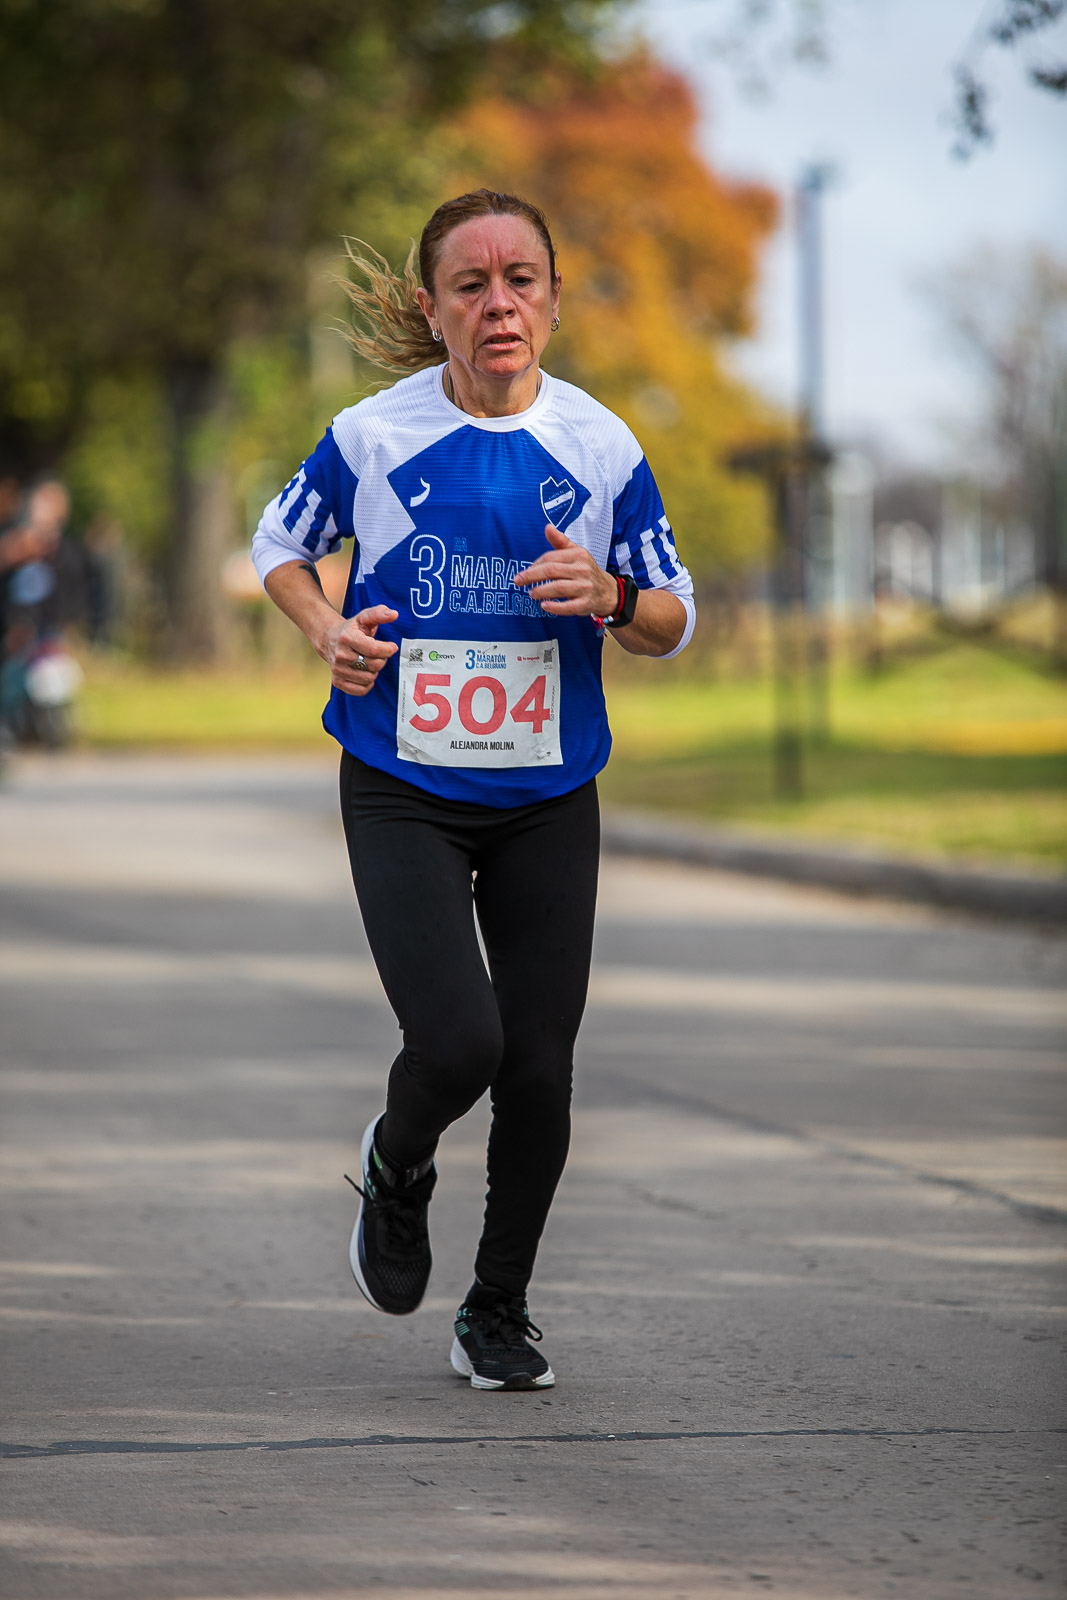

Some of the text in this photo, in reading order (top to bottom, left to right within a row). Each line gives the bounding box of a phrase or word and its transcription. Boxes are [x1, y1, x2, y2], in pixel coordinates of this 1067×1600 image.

[409, 533, 447, 620] 3
[450, 554, 555, 594] MARAT
[465, 649, 476, 670] 3
[476, 653, 507, 663] MARATÓN
[408, 673, 551, 736] 504
[449, 740, 515, 751] ALEJANDRA MOLINA
